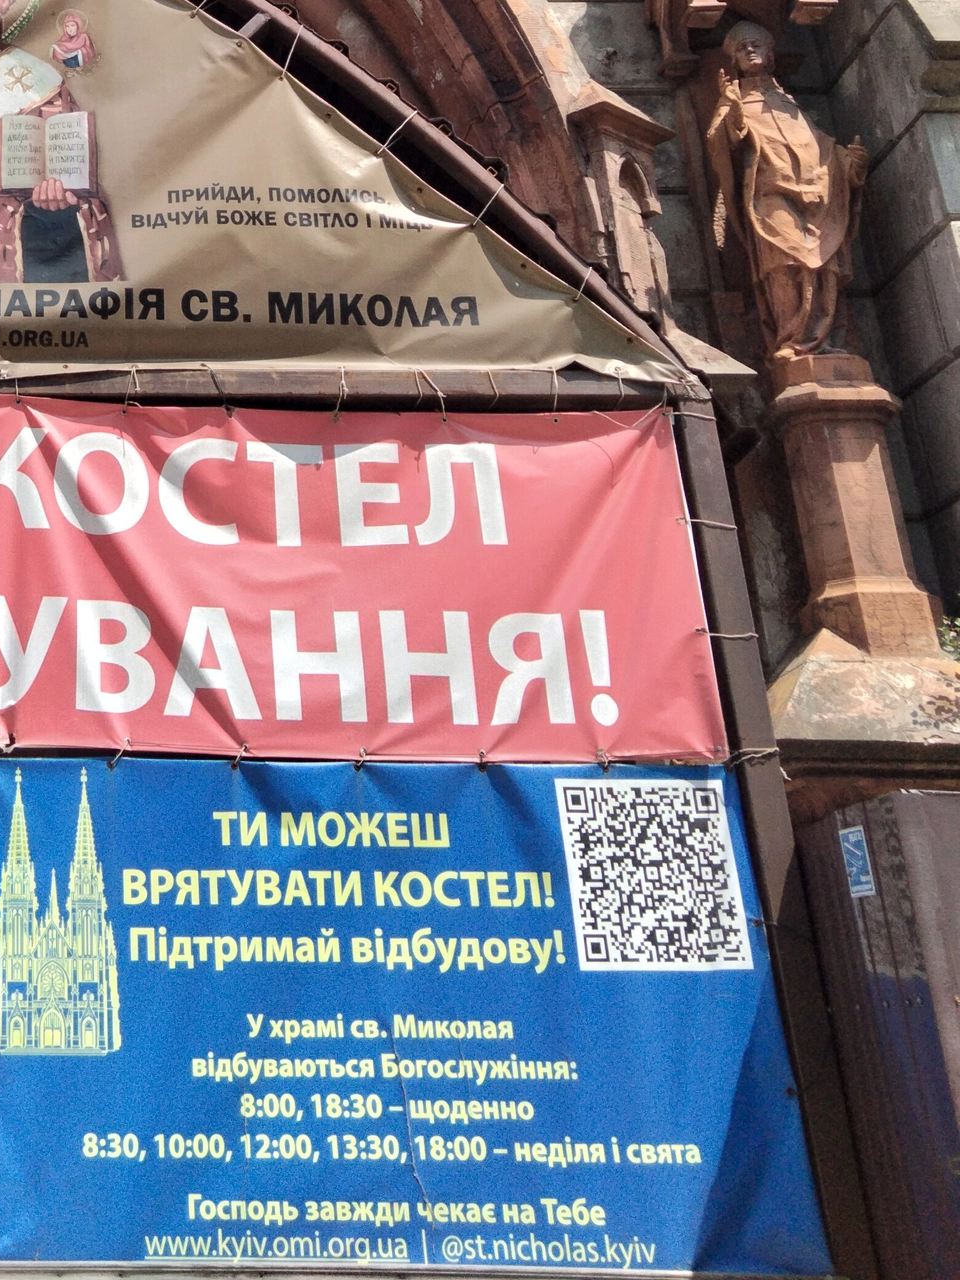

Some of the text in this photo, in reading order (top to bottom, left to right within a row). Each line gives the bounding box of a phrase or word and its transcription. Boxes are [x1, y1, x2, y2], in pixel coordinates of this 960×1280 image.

[167, 183, 391, 206] ПРИЙДИ, ПОМОЛИСЬ,
[131, 206, 208, 229] ВІДЧУЙ
[217, 210, 277, 226] БОЖЕ
[283, 211, 358, 228] СВІТЛО
[366, 213, 372, 228] І
[181, 289, 251, 323] СВ.
[268, 291, 480, 328] МИКОЛАЯ
[213, 812, 450, 847] ТИ МОЖЕШ
[123, 869, 554, 907] ВРЯТУВАТИ КОСТЕЛ!
[130, 927, 565, 973] Підтримай відбудову!
[247, 1014, 513, 1043] У храмі св. Миколая
[192, 1052, 577, 1085] відбуваються Богослужіння:
[241, 1093, 303, 1121] 8:00,
[311, 1094, 382, 1118] 18:30
[410, 1100, 534, 1124] щоденно
[83, 1133, 146, 1161] 8:30,
[155, 1134, 232, 1162] 10:00,
[241, 1134, 319, 1163] 12:00,
[327, 1135, 407, 1163] 13:30,
[415, 1136, 486, 1161] 18:00
[515, 1137, 605, 1167] неділя
[612, 1137, 620, 1163] і
[627, 1144, 701, 1164] свята
[189, 1194, 605, 1227] Господь завжди чекає на Тебе
[145, 1229, 408, 1263] www.kyiv.omi.org.ua
[441, 1232, 656, 1269] @st.nicholas.kyiv
